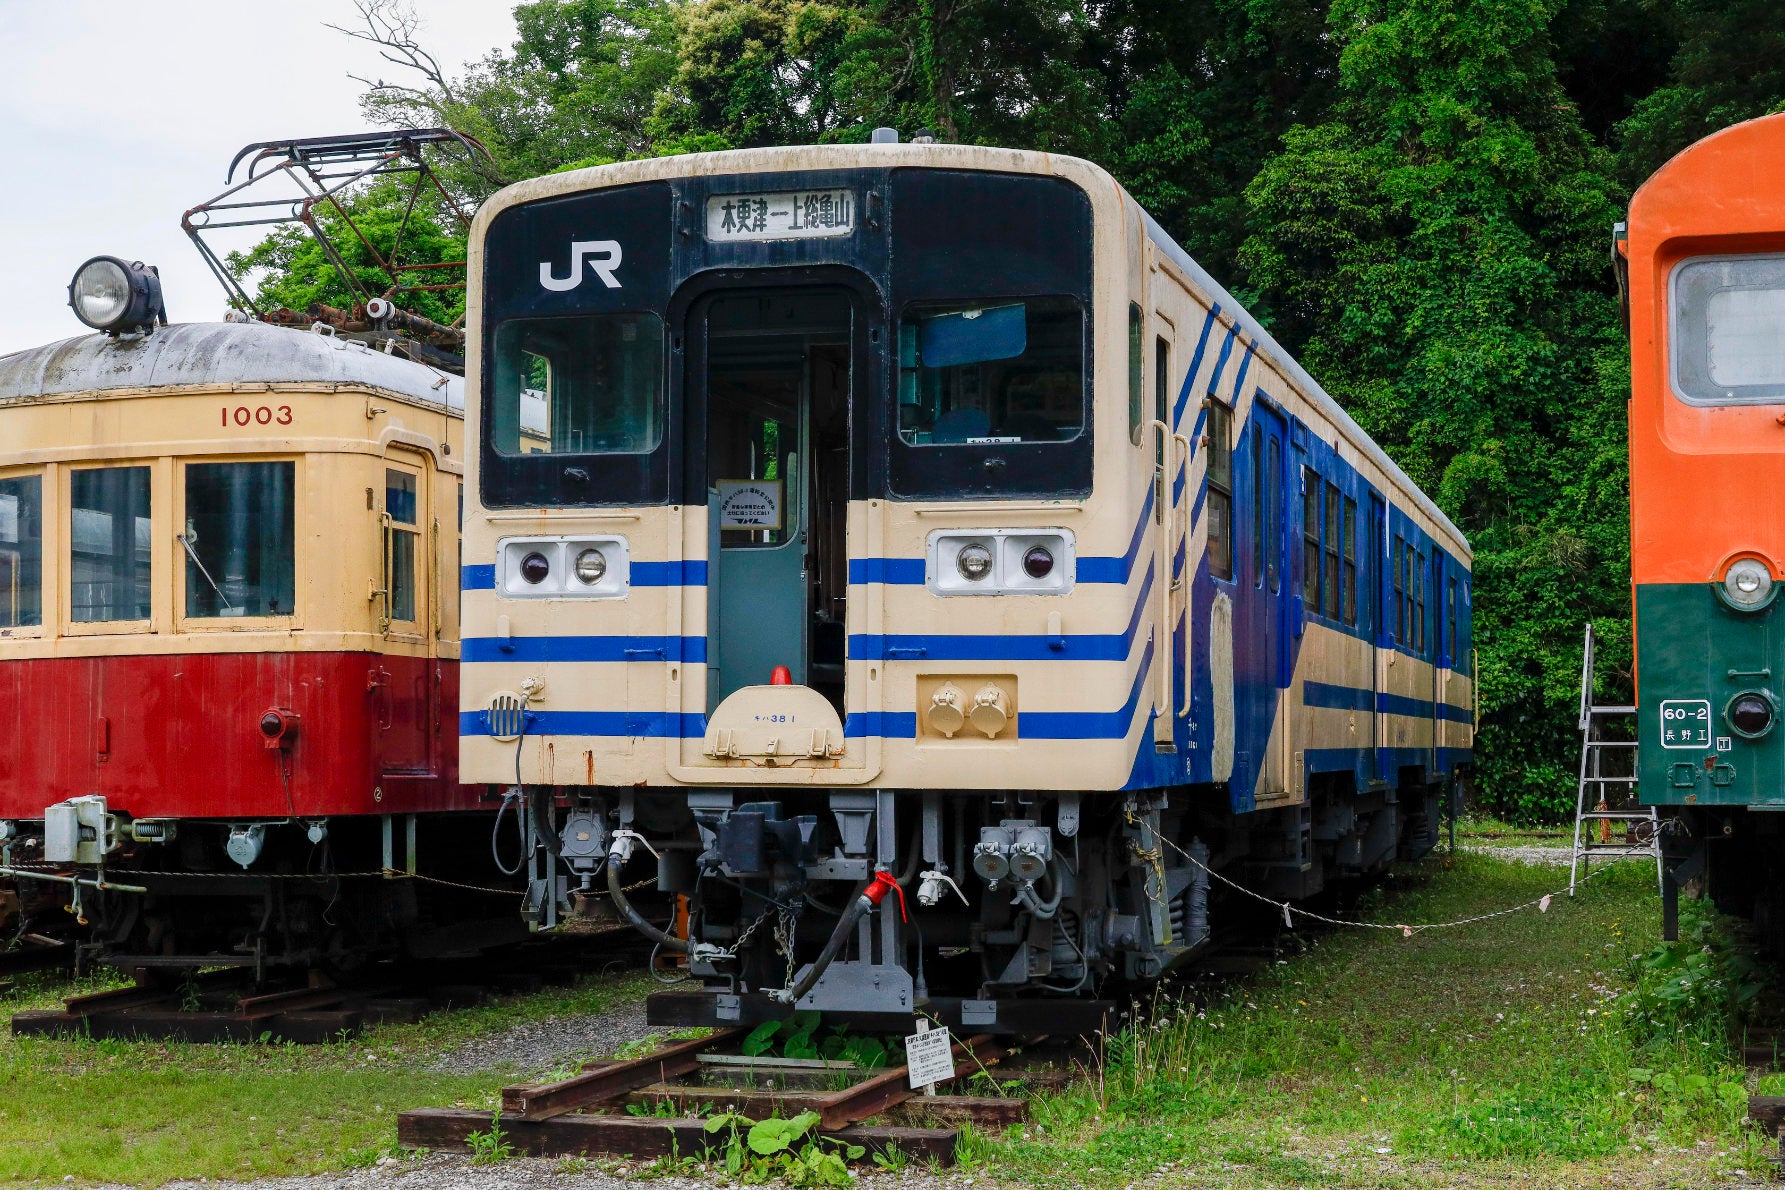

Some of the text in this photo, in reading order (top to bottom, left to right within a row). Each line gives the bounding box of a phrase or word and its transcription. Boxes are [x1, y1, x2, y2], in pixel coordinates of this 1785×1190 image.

[720, 197, 768, 234] 木更津
[539, 240, 623, 292] JR
[222, 405, 293, 427] 1003
[1664, 708, 1708, 720] 60-2
[1665, 729, 1708, 741] 長野工
